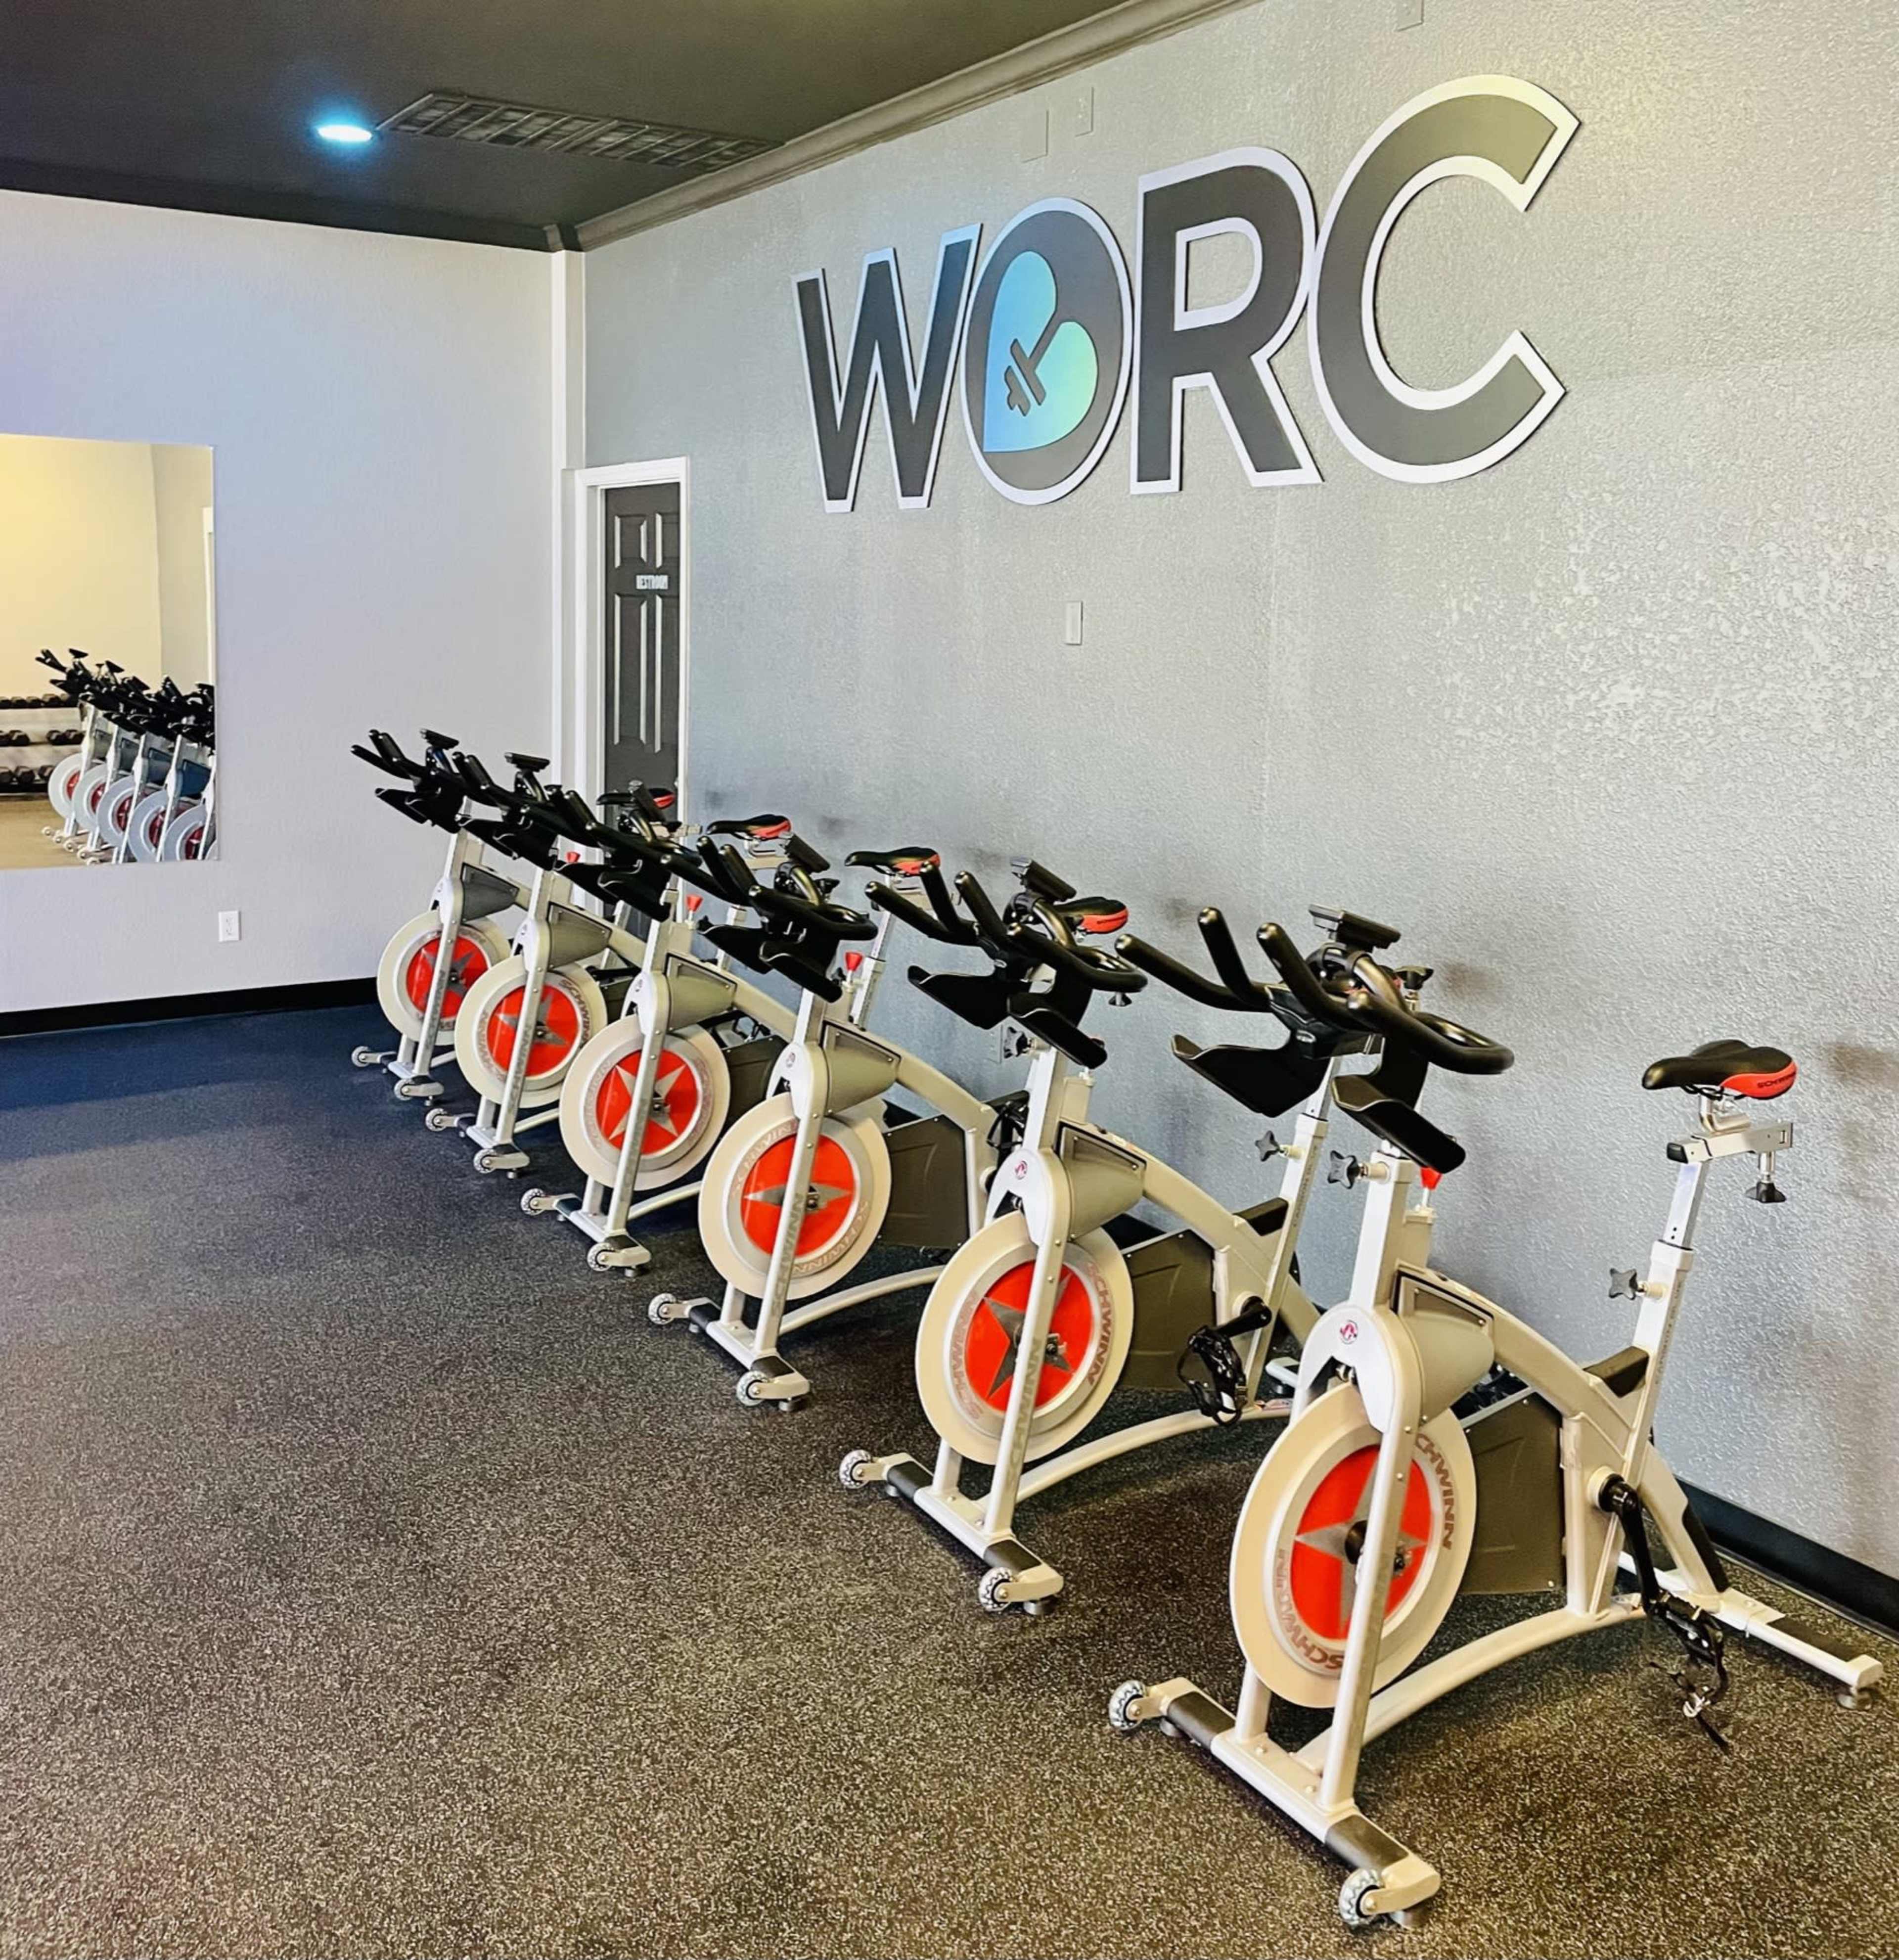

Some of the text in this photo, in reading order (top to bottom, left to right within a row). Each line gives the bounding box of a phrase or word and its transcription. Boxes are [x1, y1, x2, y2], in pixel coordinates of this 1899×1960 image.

[791, 74, 1581, 513] WORC
[1087, 1261, 1114, 1386] SCHWINN
[1415, 1433, 1455, 1550] CHWINN
